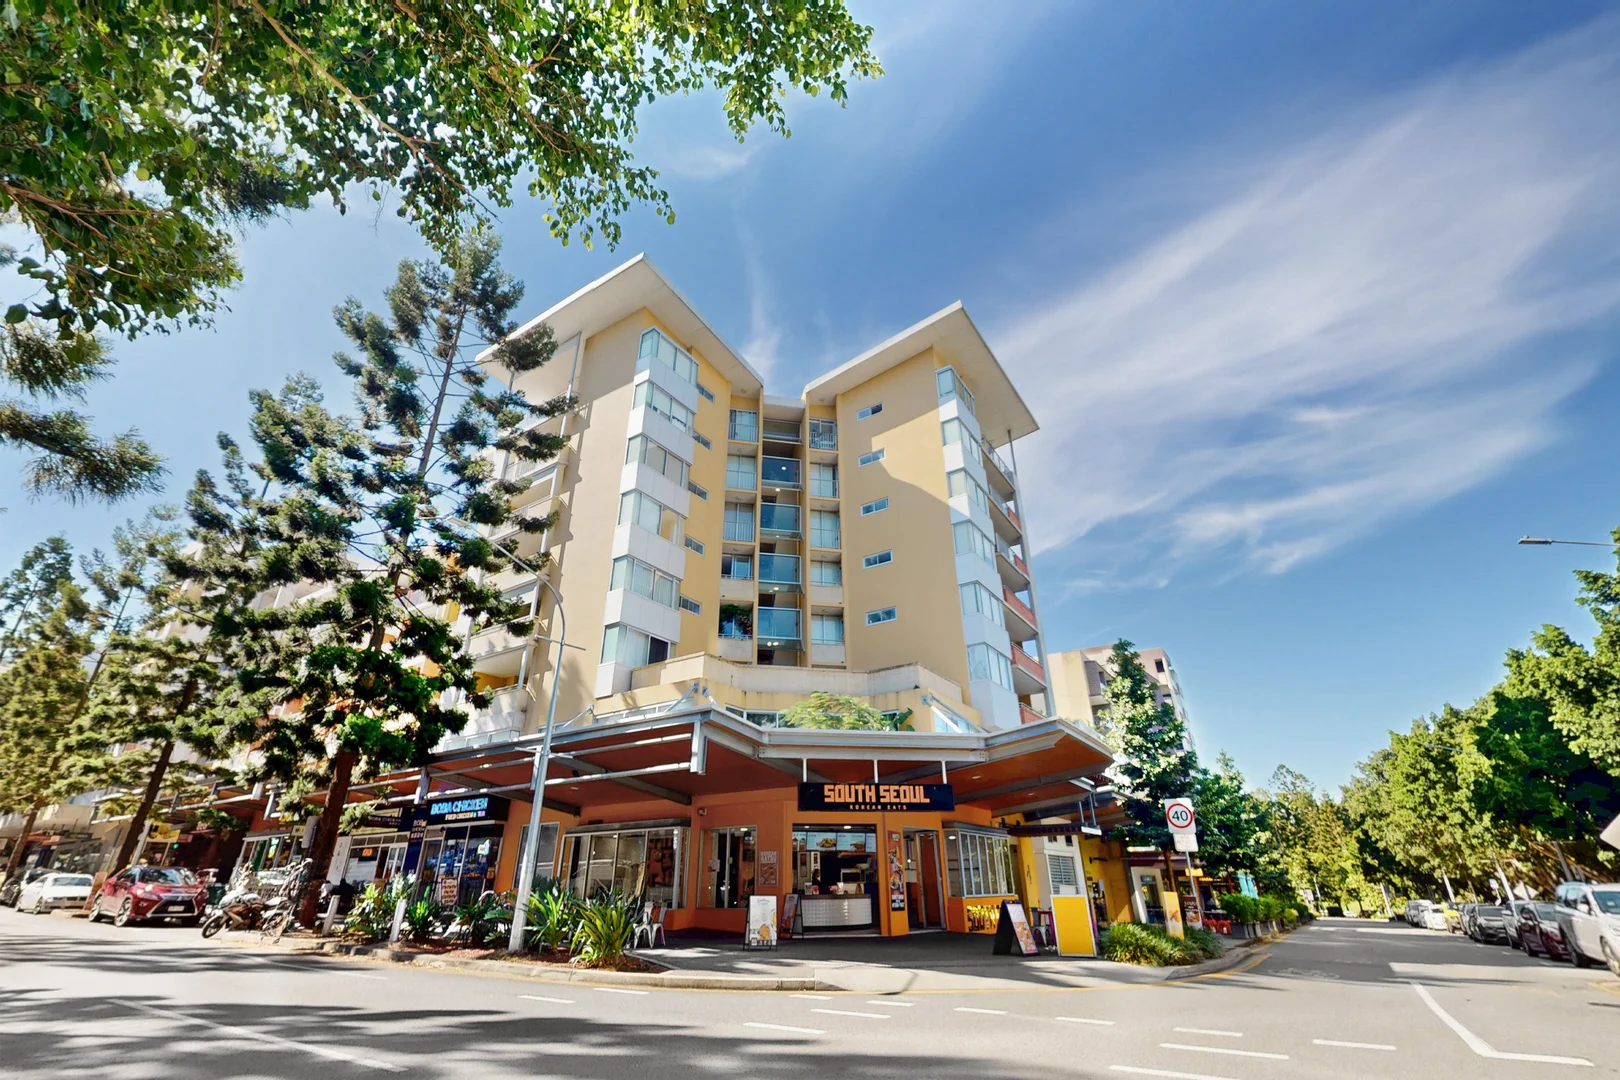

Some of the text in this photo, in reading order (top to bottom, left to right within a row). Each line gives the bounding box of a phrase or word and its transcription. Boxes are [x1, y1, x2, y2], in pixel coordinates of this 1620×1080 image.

[824, 784, 930, 804] SOUTH SEOUL
[430, 797, 489, 815] BOBA CHICKEN
[1171, 810, 1189, 822] 40
